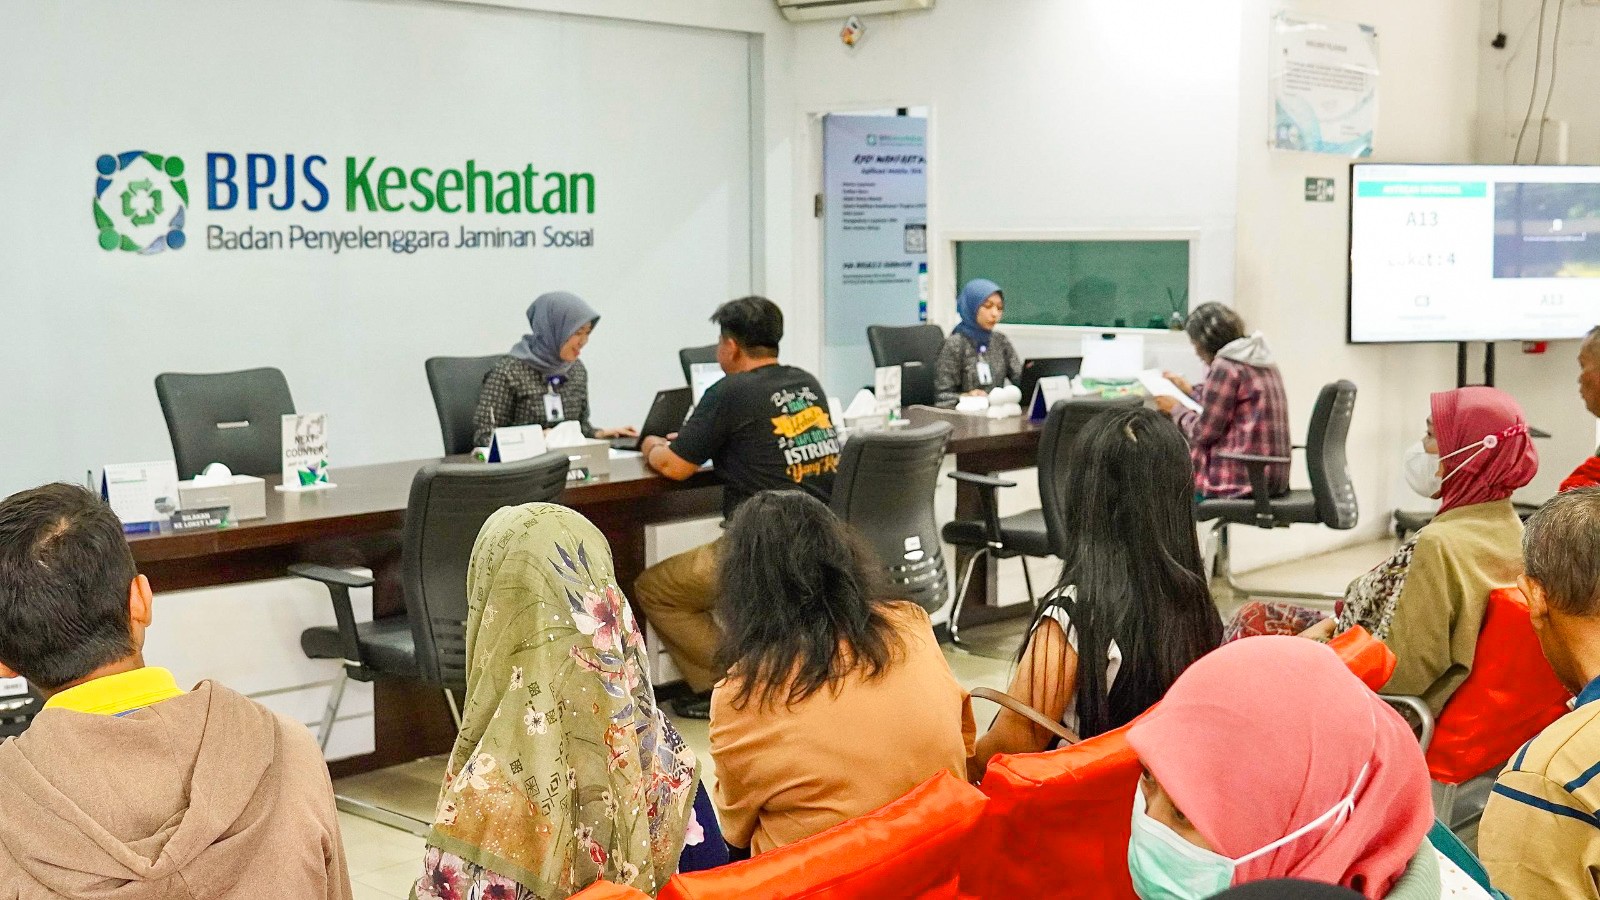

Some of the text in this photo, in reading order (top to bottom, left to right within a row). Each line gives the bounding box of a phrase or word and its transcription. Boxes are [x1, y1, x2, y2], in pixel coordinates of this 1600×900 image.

[206, 152, 596, 215] BPJS Kesehatan
[1406, 211, 1440, 227] A13
[207, 225, 594, 254] Badan Penyelenggara Jaminan Sosial
[1387, 251, 1457, 267] ket:4
[294, 433, 319, 446] NEXT
[285, 444, 325, 458] COUNTER
